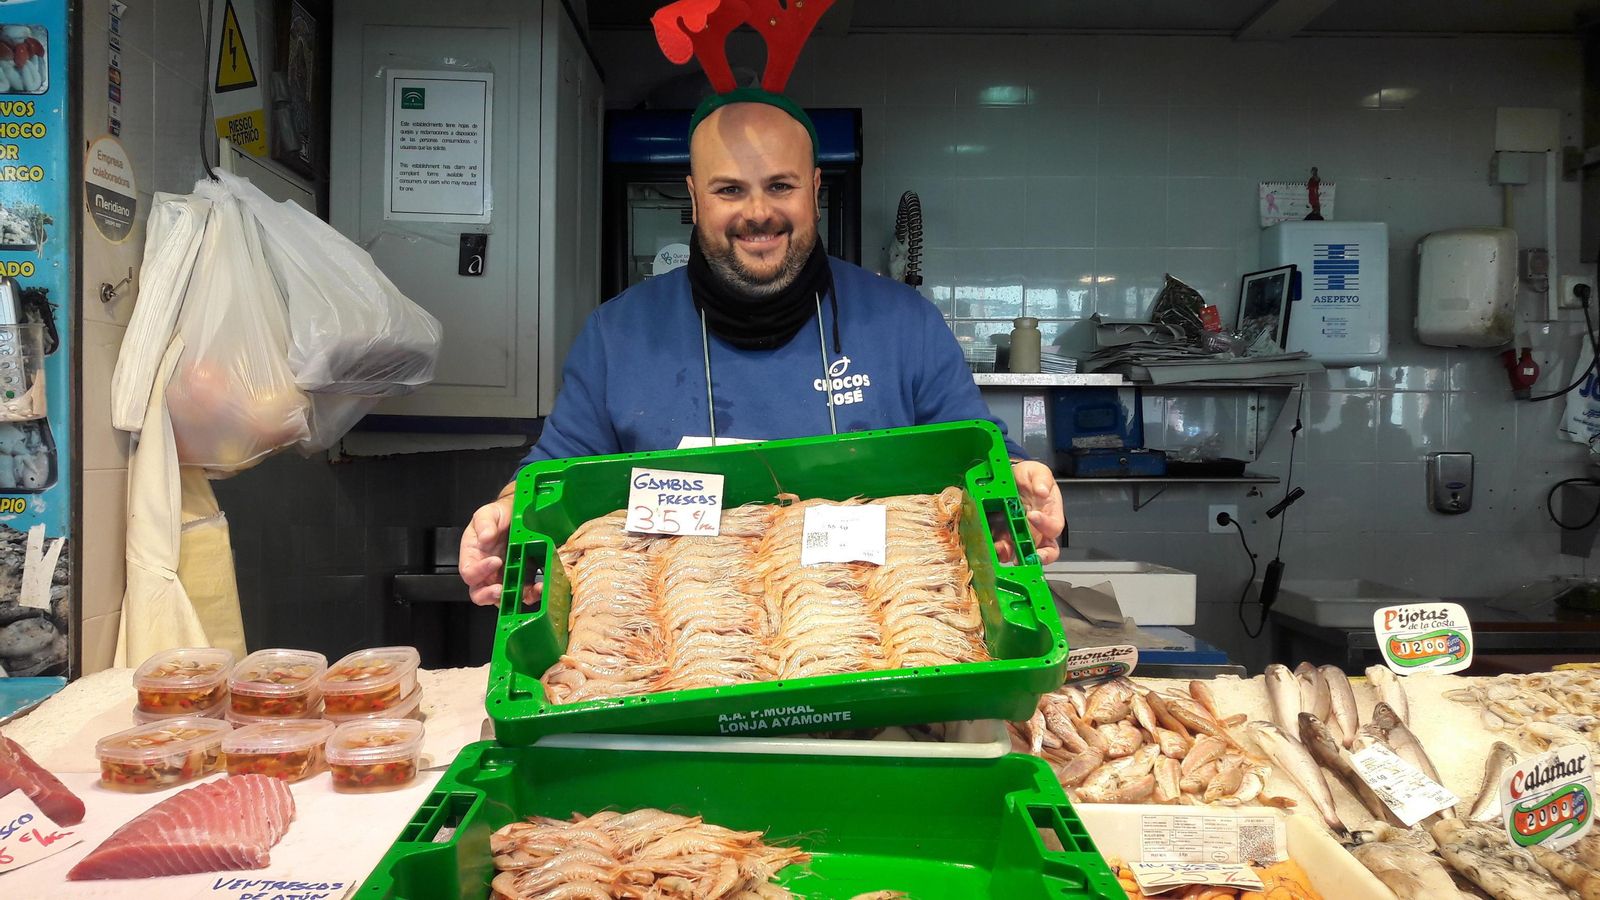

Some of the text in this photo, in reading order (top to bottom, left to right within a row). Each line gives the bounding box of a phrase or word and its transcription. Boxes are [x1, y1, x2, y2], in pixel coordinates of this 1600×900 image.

[0, 101, 35, 117] VOS
[0, 122, 46, 138] HOCO
[229, 116, 252, 134] RIESGO
[226, 128, 259, 145] LECTRICO
[97, 150, 124, 169] Empresa
[93, 167, 130, 189] colaboradora
[95, 193, 130, 217] Meridiano
[0, 261, 35, 277] ADO
[1313, 296, 1360, 304] ASEPEYO
[813, 374, 870, 391] CHOCOS
[633, 473, 704, 491] GAMBAS
[0, 498, 26, 513] PIO
[658, 494, 717, 506] FRESCAS
[1384, 608, 1449, 631] Pijotas
[1431, 619, 1455, 629] Costa
[1067, 647, 1133, 662] monetes
[719, 710, 852, 734] LONJA AYAMONTE
[1510, 754, 1587, 800] Calamar
